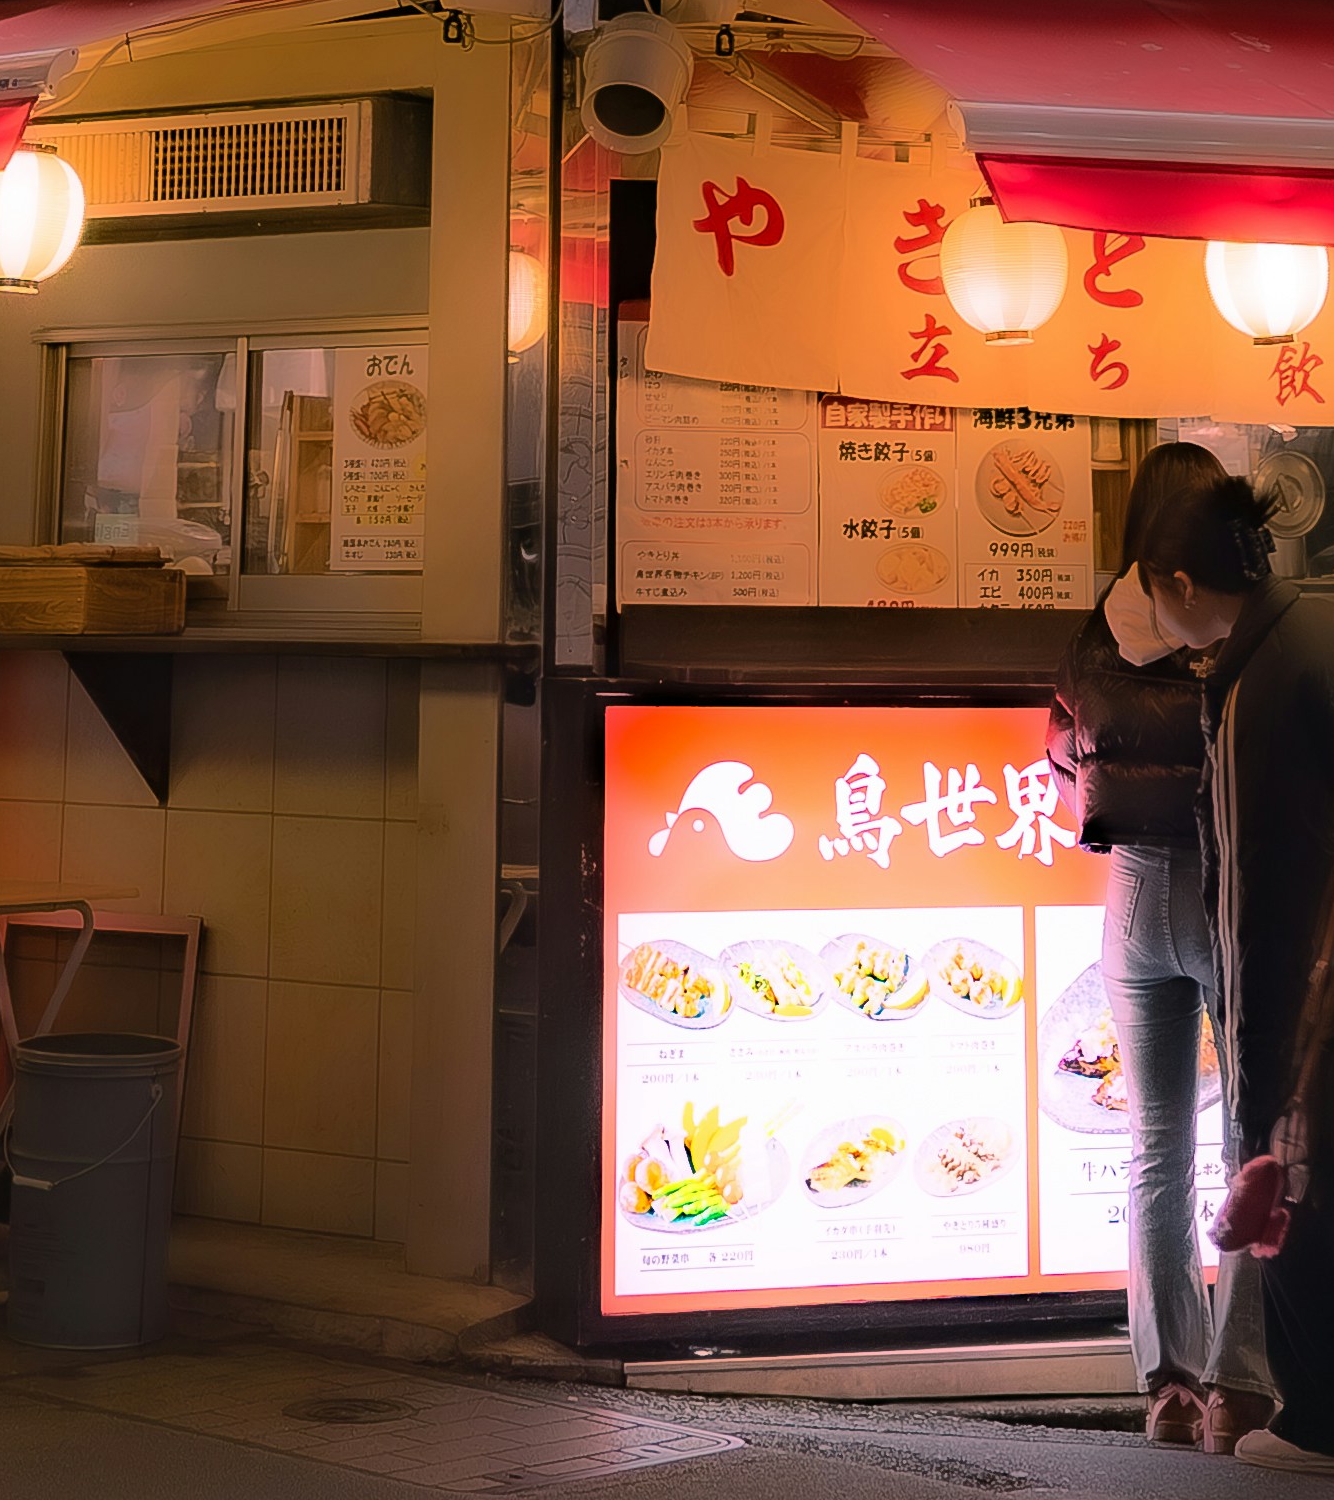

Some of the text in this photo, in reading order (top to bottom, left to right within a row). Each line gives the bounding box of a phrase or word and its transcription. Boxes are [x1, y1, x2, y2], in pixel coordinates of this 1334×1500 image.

[366, 354, 414, 378] おでん
[825, 401, 951, 431] 自家製手作り
[972, 407, 1075, 431] 海鮮3兄弟
[977, 568, 999, 582] イカ
[979, 585, 1002, 599] エビ
[817, 752, 1078, 869] 鳥世界
